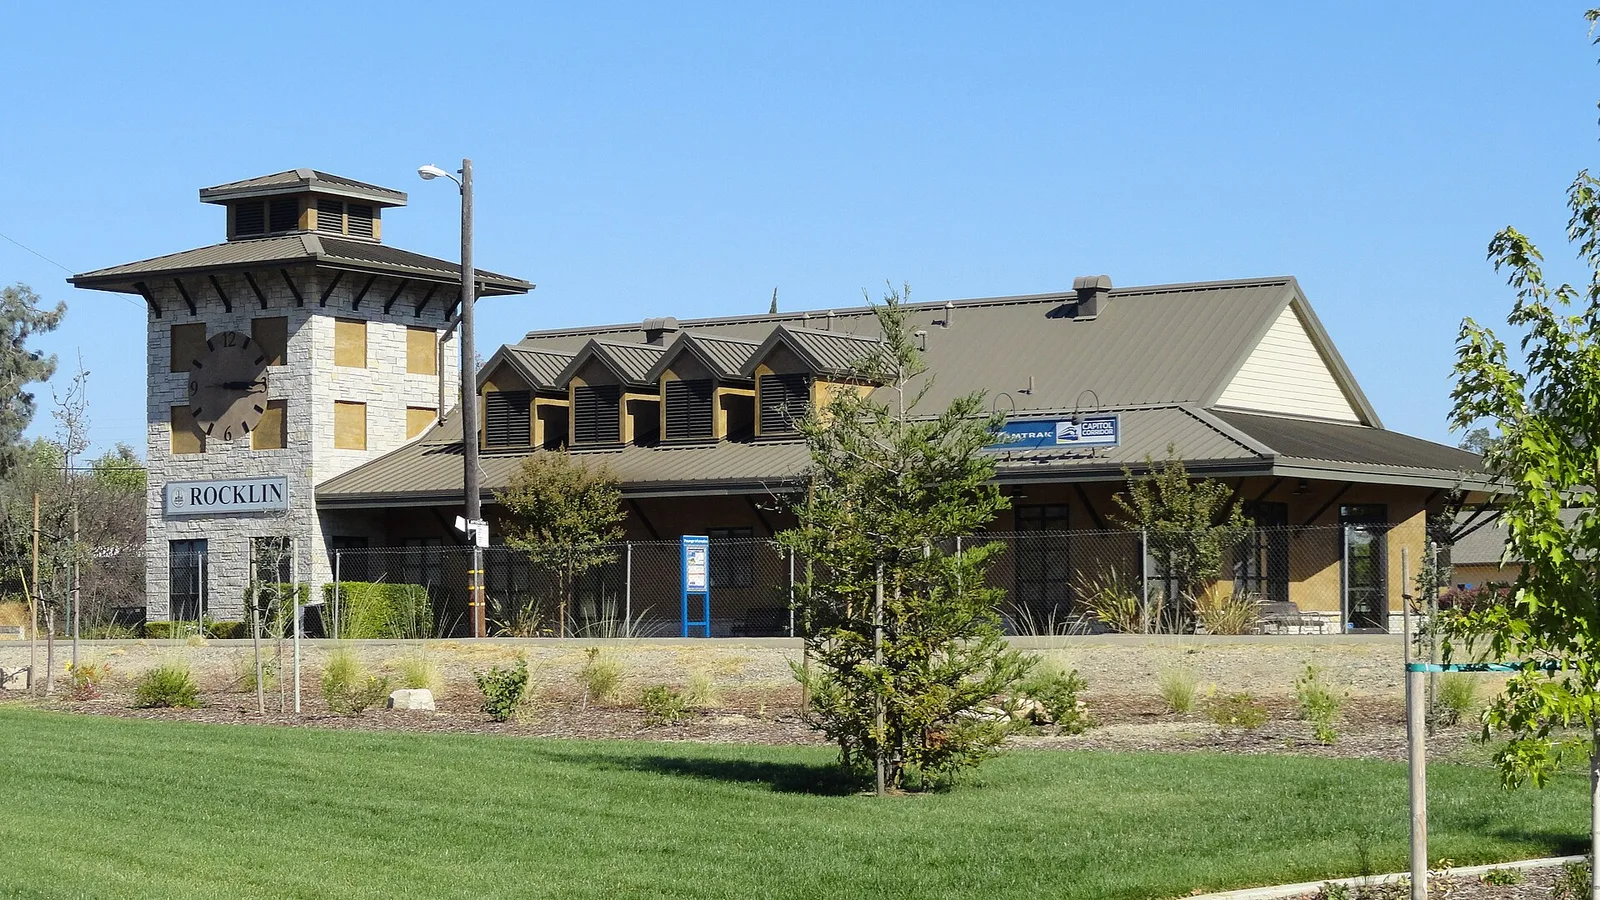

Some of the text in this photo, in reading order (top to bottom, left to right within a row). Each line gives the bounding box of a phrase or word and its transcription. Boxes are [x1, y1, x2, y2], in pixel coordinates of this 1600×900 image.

[222, 331, 236, 347] 12
[190, 381, 198, 396] 9
[224, 425, 232, 441] 6
[1082, 422, 1114, 430] CAPITOL
[190, 483, 283, 506] ROCKLIN
